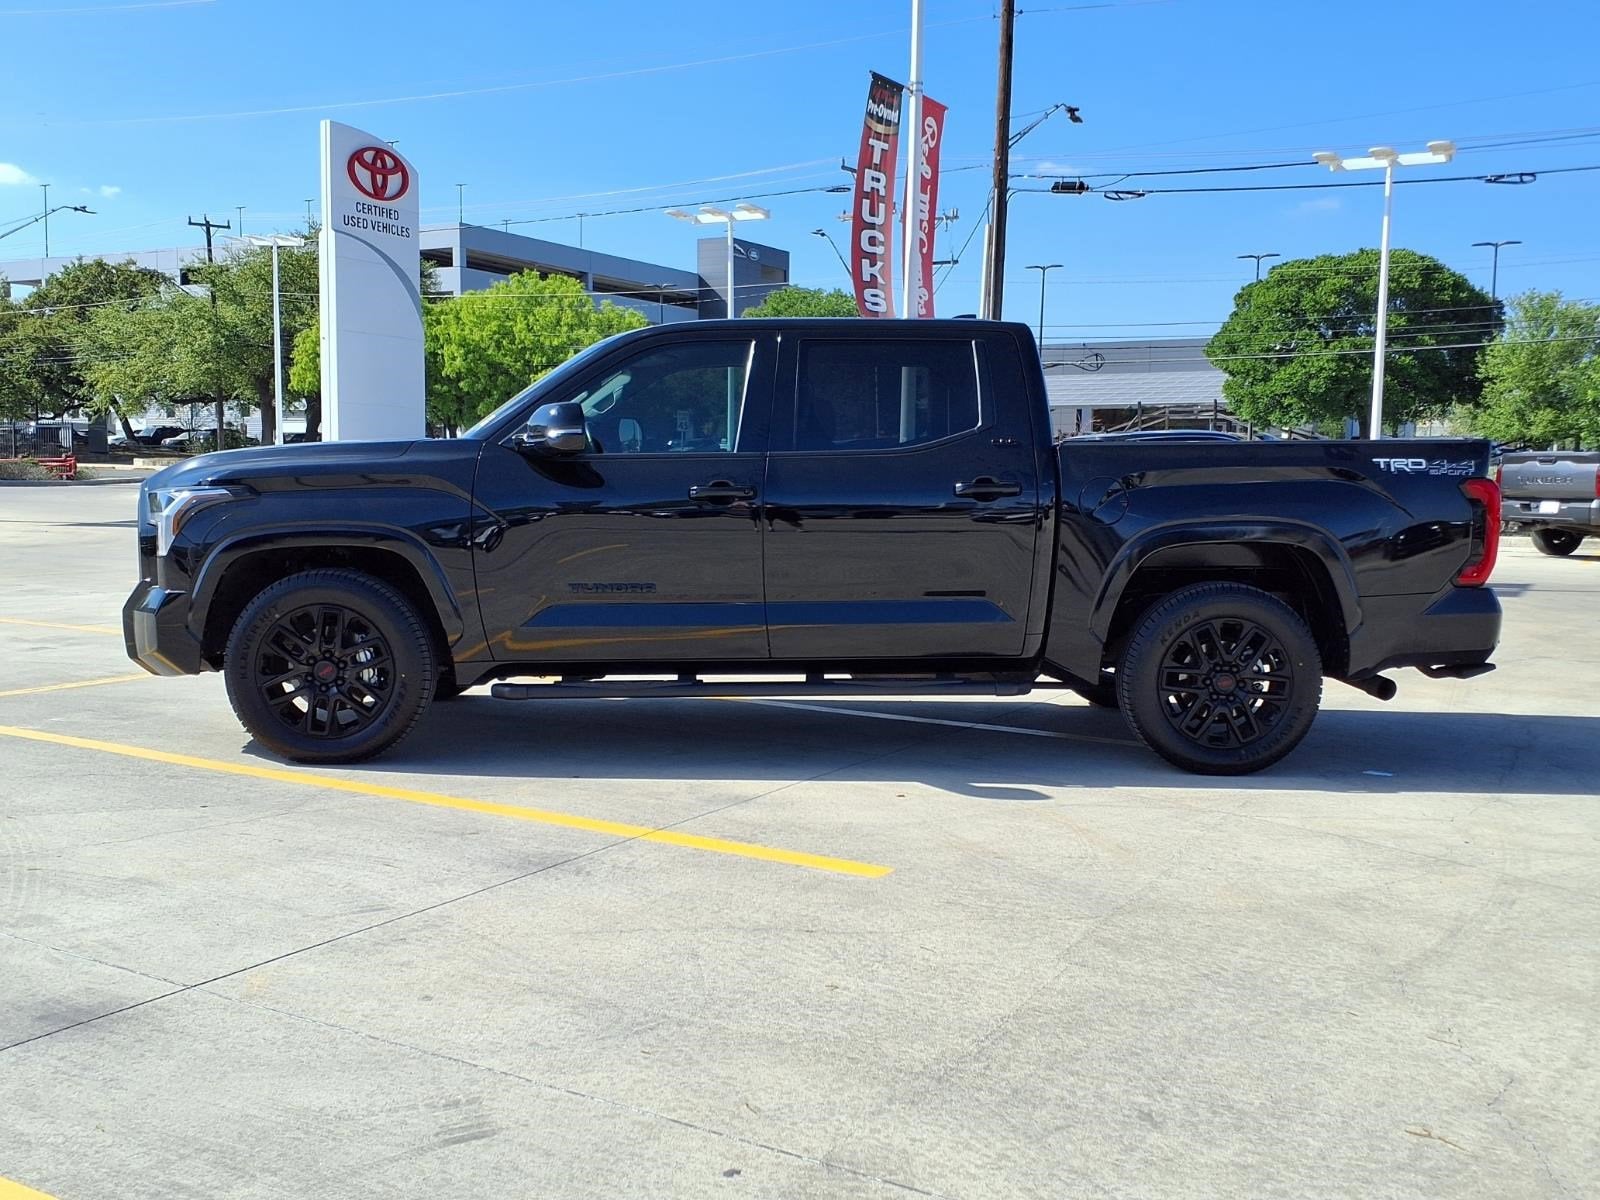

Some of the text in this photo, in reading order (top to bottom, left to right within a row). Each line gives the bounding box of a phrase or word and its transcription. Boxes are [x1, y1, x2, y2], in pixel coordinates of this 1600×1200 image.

[355, 202, 399, 220] CERTIFIED
[343, 215, 410, 238] USED VEHICLES
[860, 138, 889, 313] TRUCKS
[1371, 458, 1428, 474] TRD
[1428, 468, 1475, 476] SPORT
[1516, 475, 1575, 486] TUNDRA
[567, 581, 657, 594] TUNDRA
